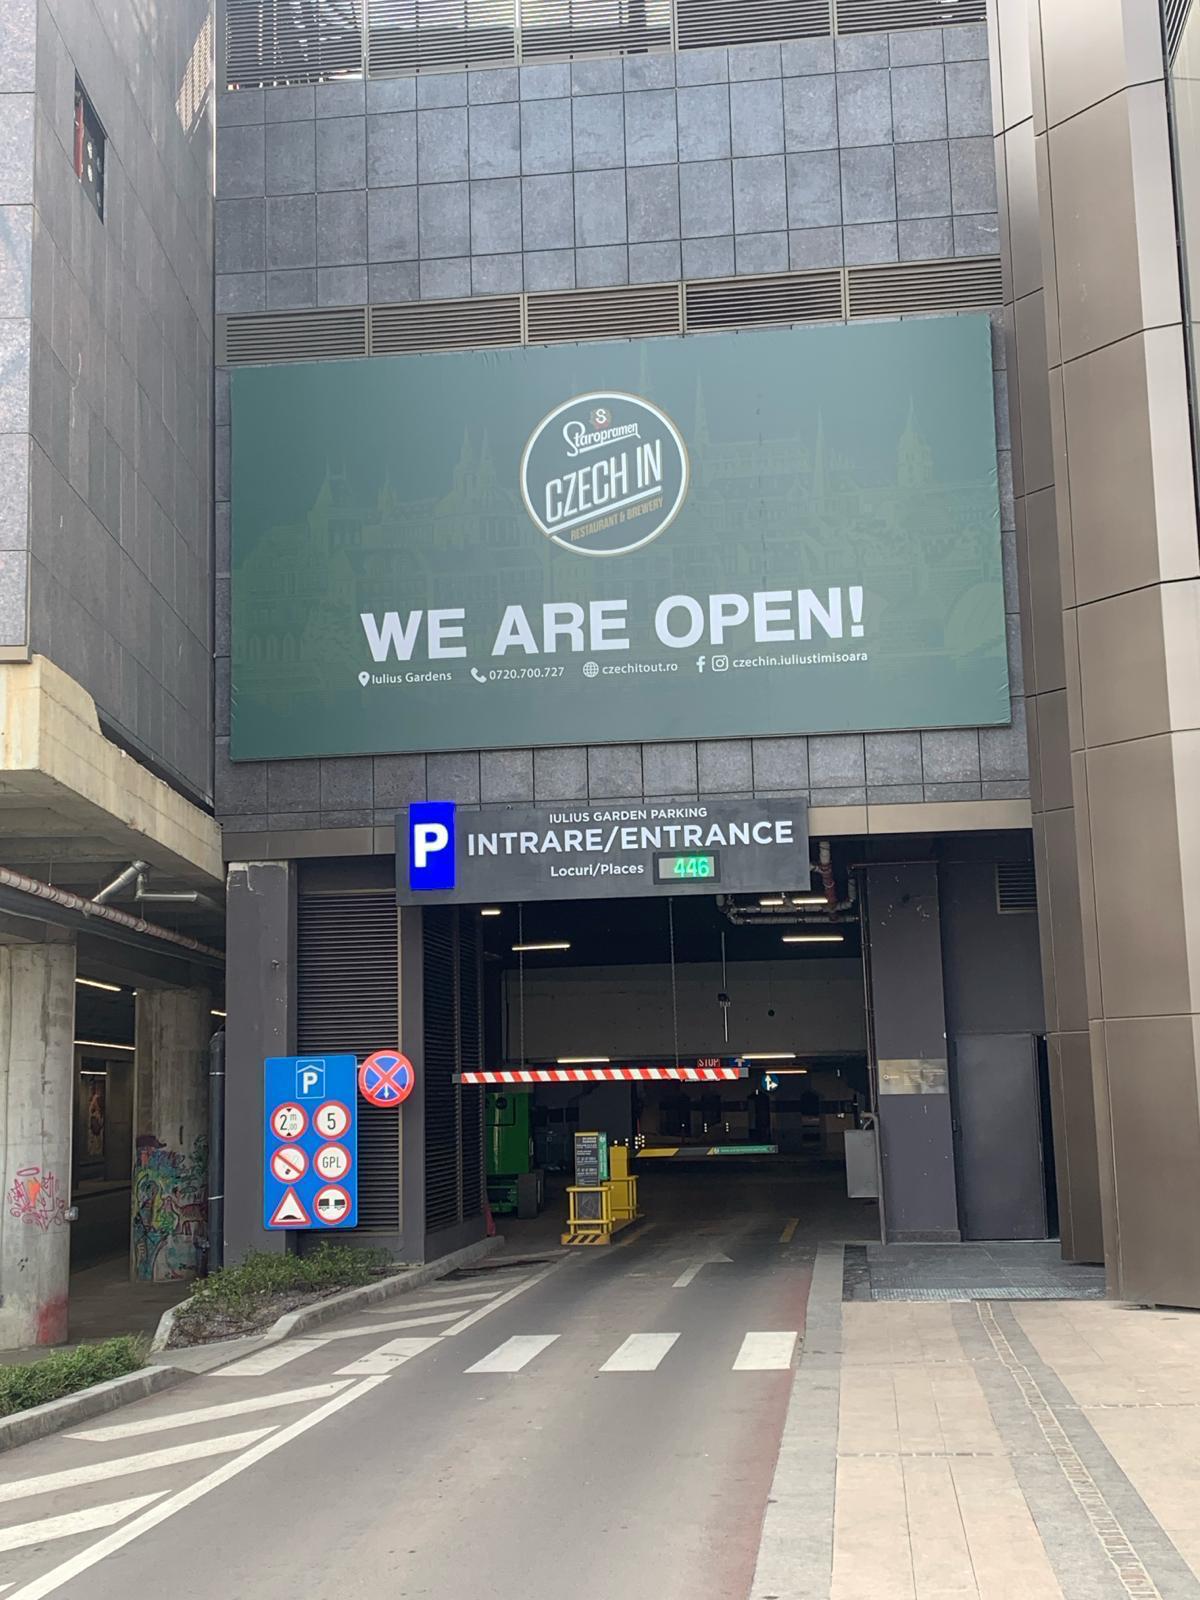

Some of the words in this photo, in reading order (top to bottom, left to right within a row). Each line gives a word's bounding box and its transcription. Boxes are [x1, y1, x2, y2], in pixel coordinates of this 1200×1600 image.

[596, 409, 607, 423] S
[563, 421, 641, 457] Staropramen
[545, 452, 628, 523] CZECH
[636, 439, 662, 489] IN
[571, 513, 619, 541] RESTAURANT
[620, 511, 626, 523] &
[627, 496, 663, 520] BREWERY
[360, 608, 467, 662] WE
[491, 599, 630, 656] ARE
[655, 586, 865, 648] OPEN!
[602, 661, 678, 675] czechitout.ro
[732, 652, 868, 669] czechin.iuliustimisoara
[372, 672, 402, 684] Iulius
[405, 671, 452, 684] Gardens
[489, 667, 565, 681] 0720.700.727
[550, 812, 590, 824] IULIUS
[593, 810, 647, 822] GARDEN
[651, 807, 708, 819] PARKING
[413, 823, 449, 868] P
[468, 820, 794, 856] INTRARE/ENTRANCE
[551, 863, 644, 878] Locuri/Places
[674, 856, 710, 878] 446
[698, 1058, 719, 1067] STOP
[303, 1072, 318, 1094] P
[327, 1112, 336, 1130] 5
[322, 1156, 341, 1169] GPL
